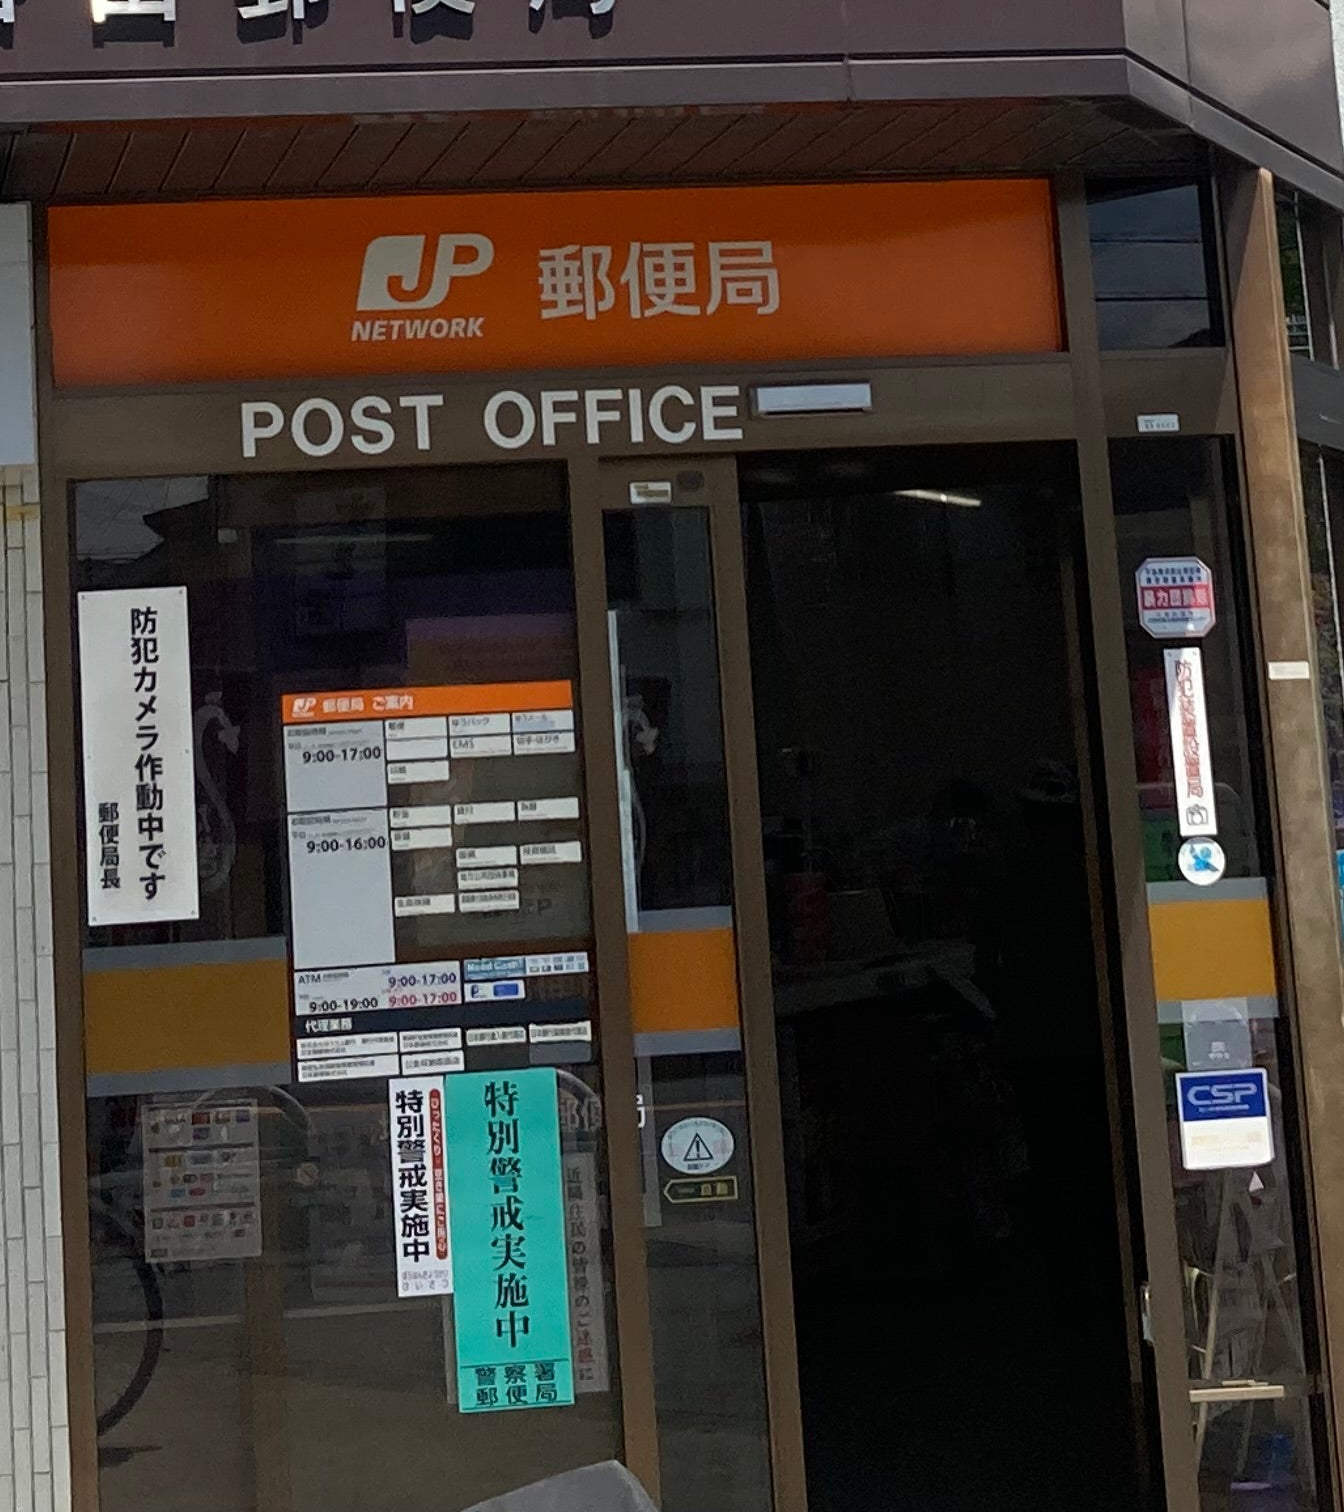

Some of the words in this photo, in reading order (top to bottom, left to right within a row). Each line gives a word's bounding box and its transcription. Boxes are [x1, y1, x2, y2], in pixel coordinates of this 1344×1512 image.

[356, 232, 495, 312] JP
[538, 240, 780, 320] 郵便局
[351, 316, 485, 342] NETWORK
[241, 394, 444, 458] POST
[483, 385, 744, 450] OFFICE
[372, 694, 414, 711] ご案内
[130, 606, 167, 900] 防犯カメラ作動中です
[98, 802, 121, 890] 郵便局長
[298, 973, 321, 984] ATM
[1187, 1082, 1258, 1106] CSP
[395, 1089, 430, 1262] 特別警戒実施中
[484, 1080, 530, 1348] 特別警戒実施中
[475, 1362, 556, 1386] 警察署
[475, 1382, 558, 1409] 郵便局
